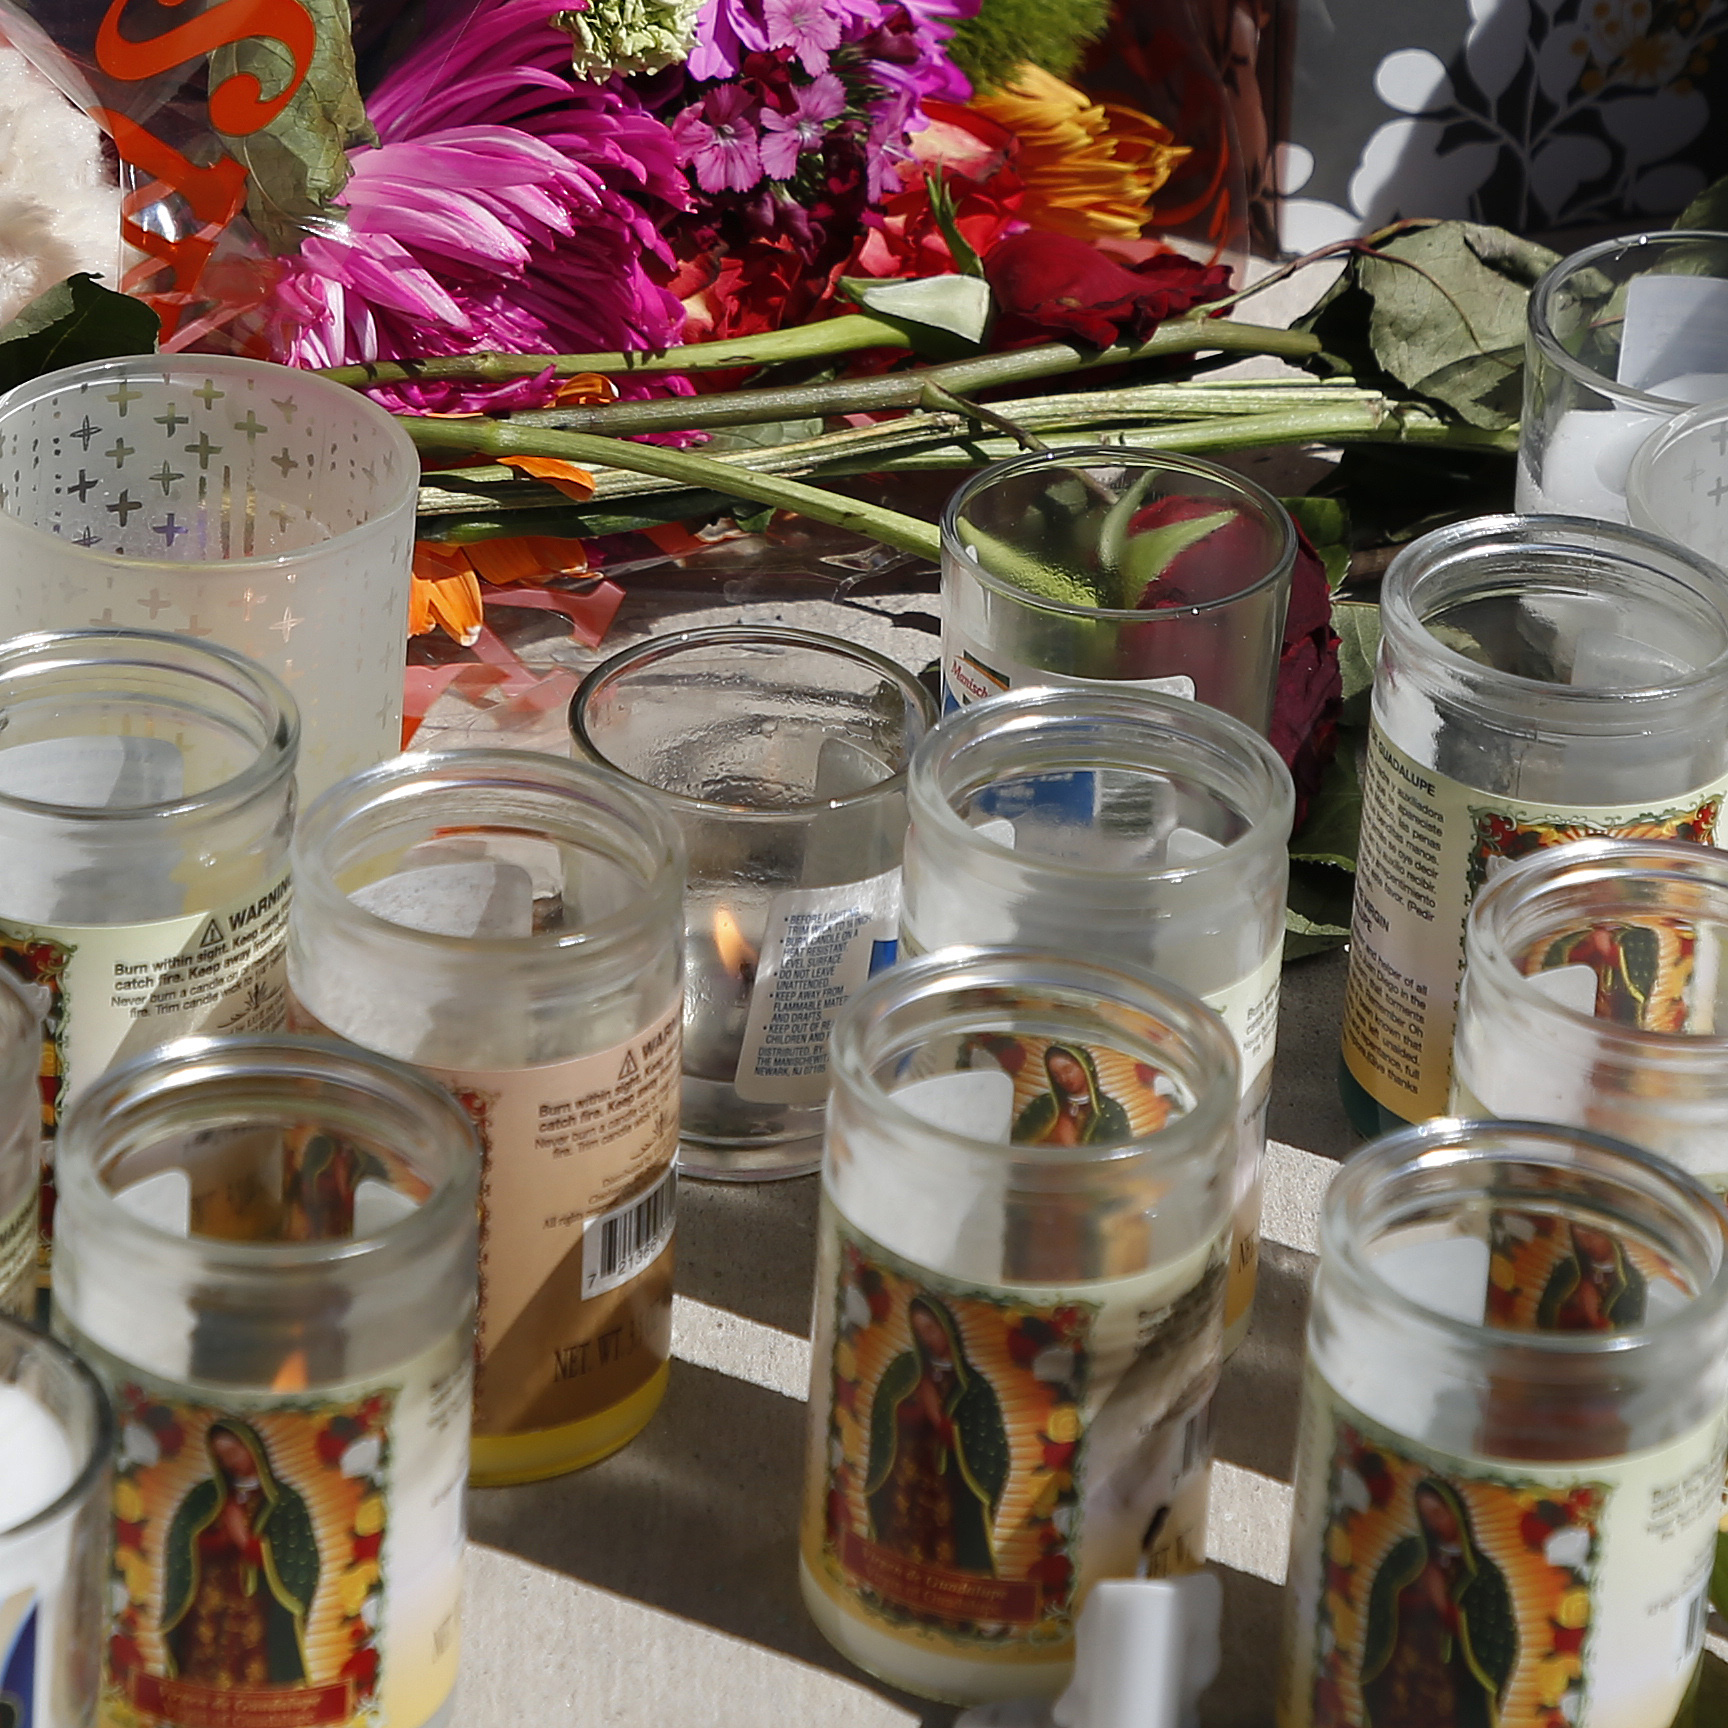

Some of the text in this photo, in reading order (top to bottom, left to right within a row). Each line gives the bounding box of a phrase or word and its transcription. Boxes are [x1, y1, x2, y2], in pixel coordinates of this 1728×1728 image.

[1378, 743, 1436, 799] GUADALUPE
[1415, 858, 1439, 880] decir
[228, 875, 292, 933] WARNIN
[790, 913, 822, 923] BEFORE
[788, 924, 809, 936] TRIM
[114, 962, 148, 976] Burn
[152, 955, 192, 972] within
[196, 944, 229, 964] sight.
[114, 961, 221, 991] catch fire. Keep
[779, 965, 836, 980] DO NOT LEAVE
[110, 994, 147, 1008] Never
[189, 978, 224, 996] candle
[774, 986, 844, 1002] KEEP AWAY FROM
[1410, 992, 1427, 1012] the
[155, 1003, 180, 1016] Trim
[182, 992, 219, 1011] candle
[773, 999, 821, 1013] FLAMMABLE
[772, 1011, 790, 1023] AND
[765, 1031, 825, 1045] CHILDREN AND
[768, 1022, 821, 1035] KEEP OUT OF
[1403, 1034, 1423, 1054] that
[757, 1056, 772, 1067] THE
[1387, 1068, 1419, 1095] thanks
[538, 1088, 612, 1118] Burn within
[538, 1115, 576, 1133] catch
[534, 1134, 569, 1150] Never
